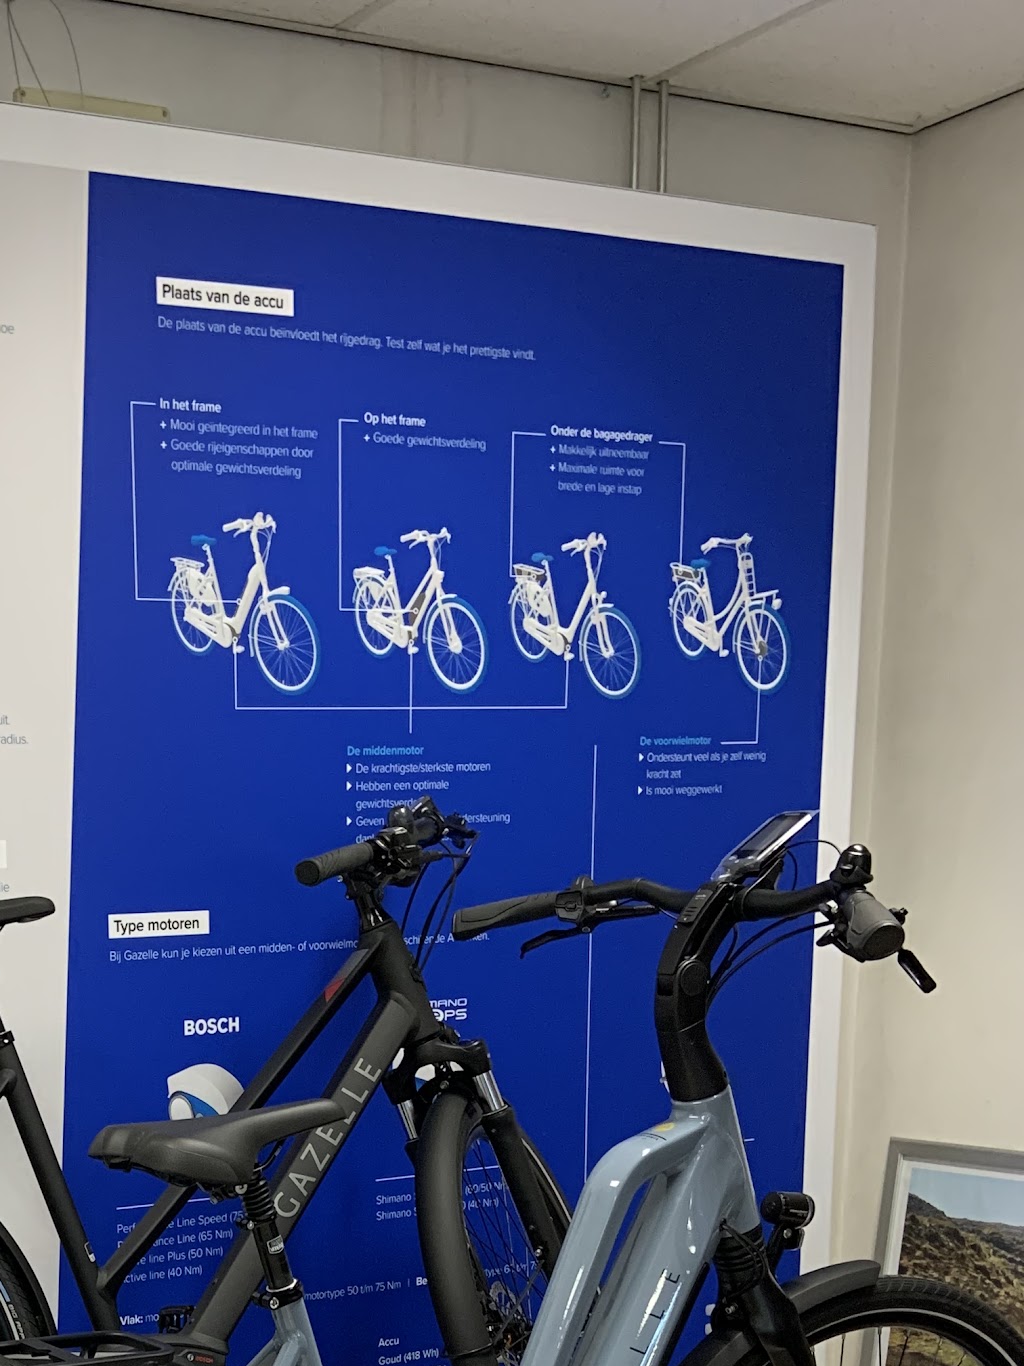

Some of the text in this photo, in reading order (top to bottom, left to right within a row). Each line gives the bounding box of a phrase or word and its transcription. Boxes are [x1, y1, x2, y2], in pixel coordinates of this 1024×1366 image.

[162, 283, 283, 309] Plaats van de accu
[159, 397, 221, 413] In het frame
[364, 411, 426, 427] Op het frame
[170, 417, 195, 431] Mooi
[262, 424, 271, 436] in
[273, 425, 289, 437] het
[291, 426, 318, 439] frame
[550, 424, 653, 444] Onder de bagagedrager
[372, 431, 486, 452] Goede gewichtsverdeling
[639, 735, 711, 746] De voorwielmotor
[347, 745, 424, 756] De middenmotor
[355, 762, 369, 774] De
[455, 762, 490, 772] motoren
[113, 918, 199, 936] Type motoren
[109, 940, 308, 963] Bij Gazelle kun je kiezen uit een midden- of
[429, 998, 468, 1008] MANO
[184, 1016, 239, 1036] BOSCH
[378, 1193, 411, 1205] Shimano
[378, 1209, 411, 1221] Shimano
[177, 1228, 233, 1244] Line (65 Nm)
[149, 1264, 202, 1279] line (40 Nm)
[378, 1337, 399, 1347] Accu
[378, 1347, 439, 1365] Goud (418 Wh)
